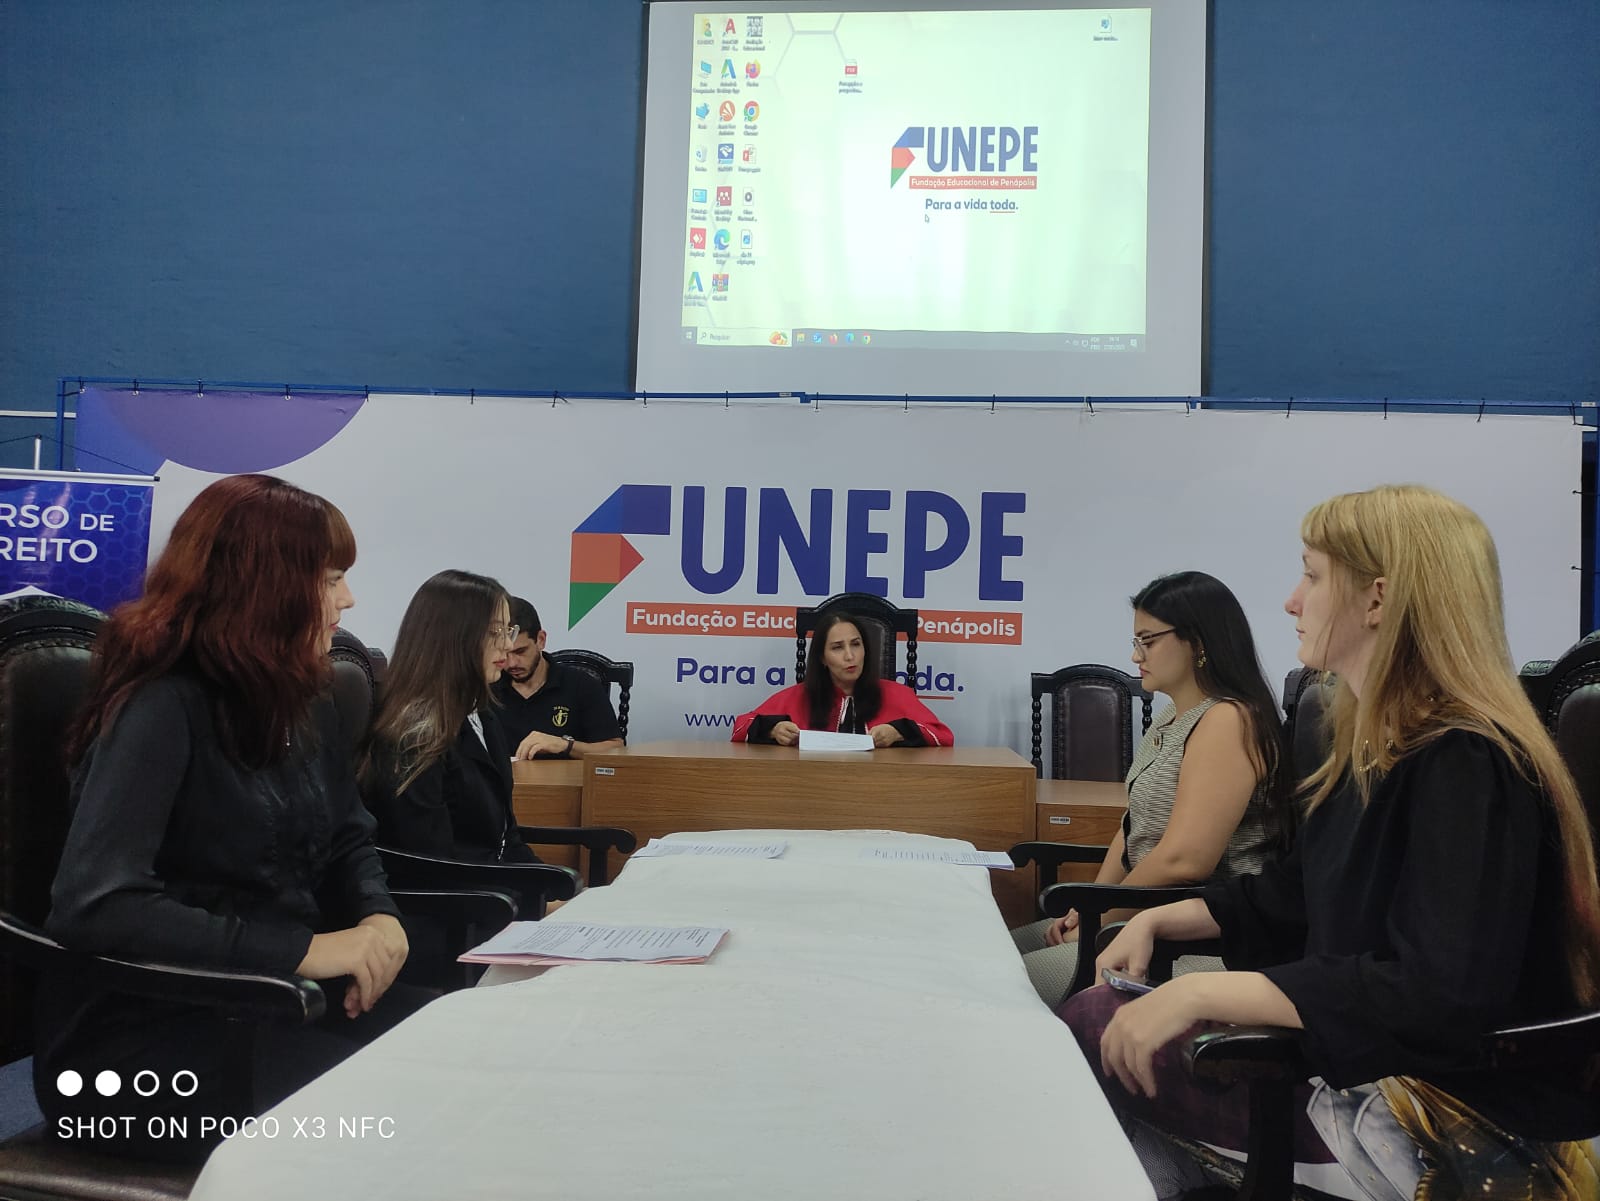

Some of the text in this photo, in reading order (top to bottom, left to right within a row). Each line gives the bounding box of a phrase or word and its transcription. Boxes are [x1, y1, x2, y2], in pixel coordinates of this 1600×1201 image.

[911, 178, 1035, 188] Fundação Educacional de Penápolis
[925, 198, 1019, 210] Para a vida toda.
[80, 513, 114, 532] DE
[632, 608, 736, 632] Fundação
[742, 611, 797, 629] Educ
[676, 657, 755, 685] Para
[765, 667, 785, 685] a
